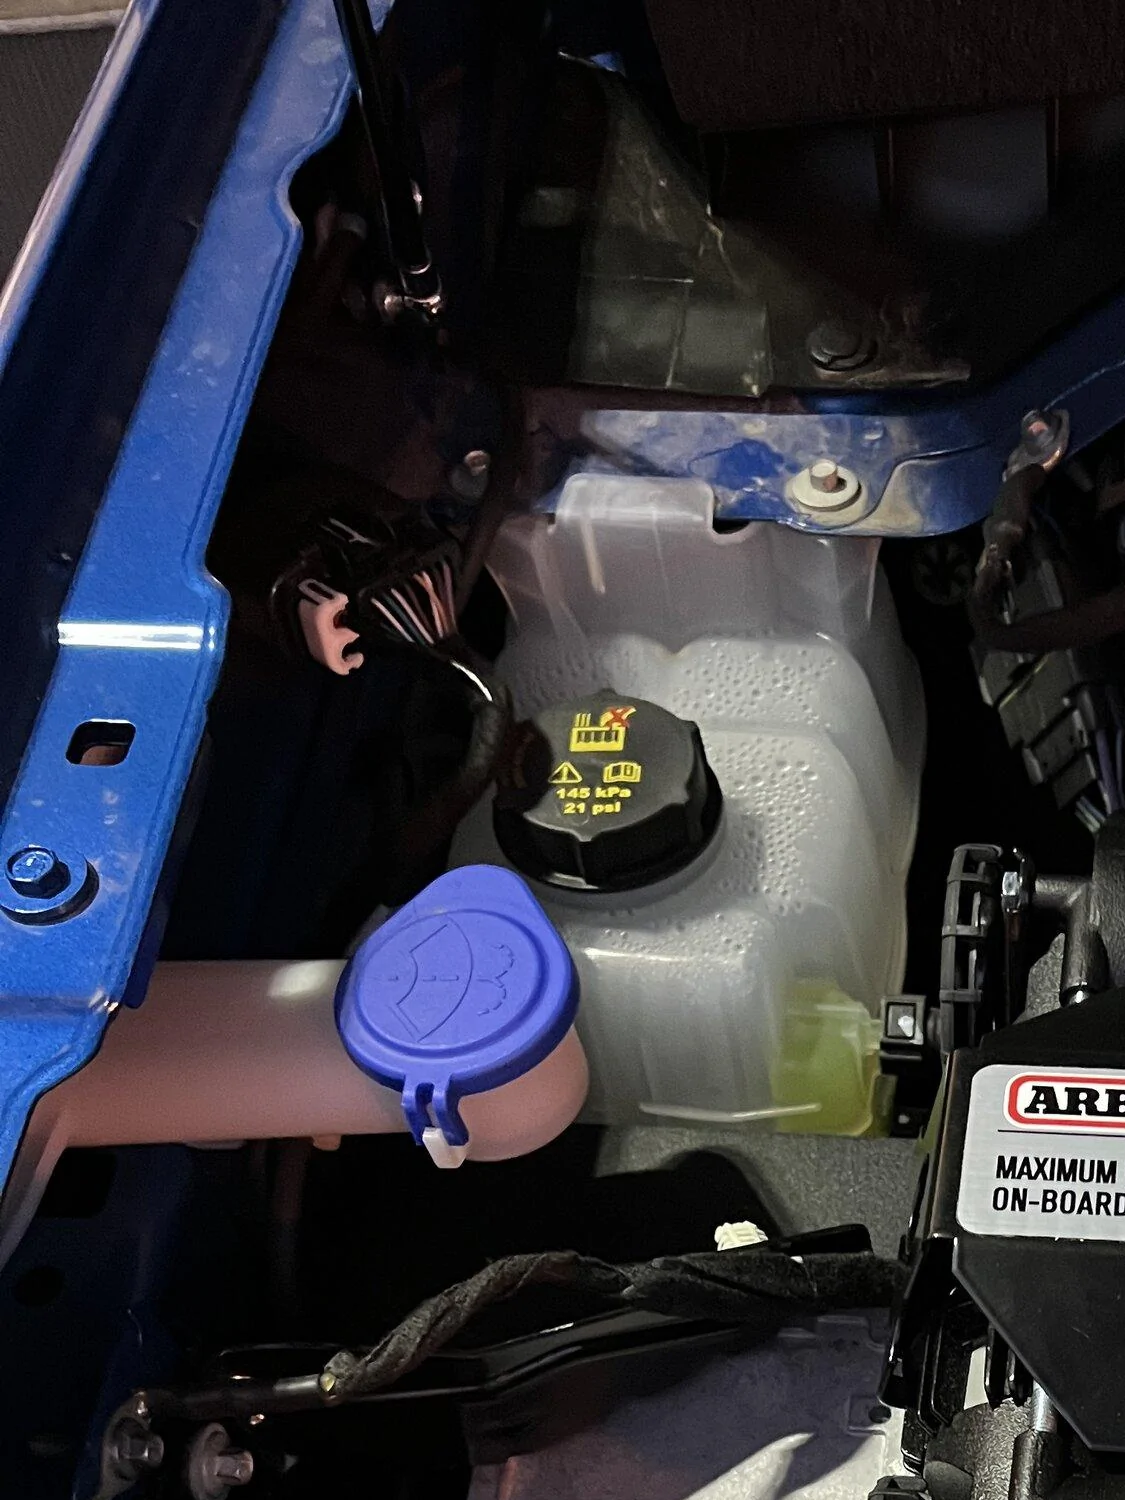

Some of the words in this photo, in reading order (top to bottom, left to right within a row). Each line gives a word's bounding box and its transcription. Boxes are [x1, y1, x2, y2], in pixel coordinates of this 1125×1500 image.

[556, 787, 591, 799] 145
[595, 786, 631, 798] kPa
[563, 802, 586, 814] 21
[592, 801, 621, 815] psi
[995, 1155, 1117, 1185] MAXIMUM
